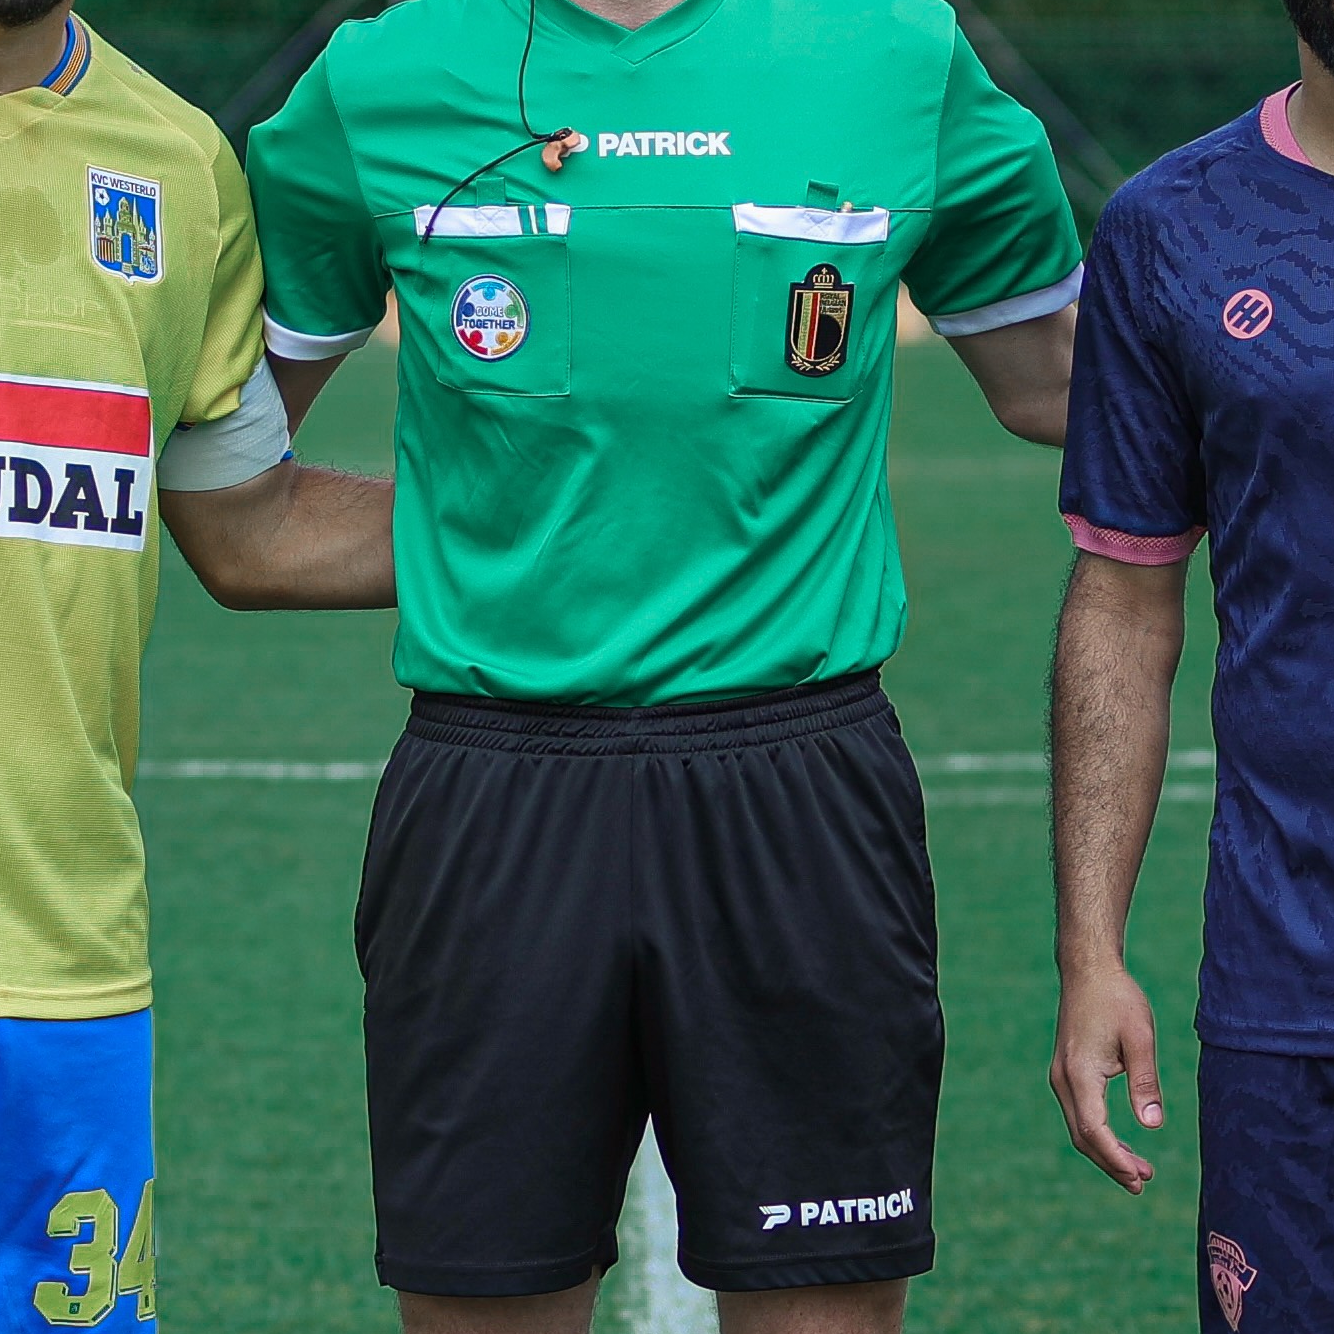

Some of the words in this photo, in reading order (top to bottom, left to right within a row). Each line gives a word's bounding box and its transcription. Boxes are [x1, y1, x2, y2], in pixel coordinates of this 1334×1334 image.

[598, 132, 731, 157] PATRICK
[91, 172, 108, 185] KVC
[109, 177, 156, 197] WESTERLO
[463, 319, 515, 329] TOGETHER
[475, 306, 504, 317] COME
[800, 1188, 914, 1227] PATRICK
[34, 1178, 156, 1326] 34
